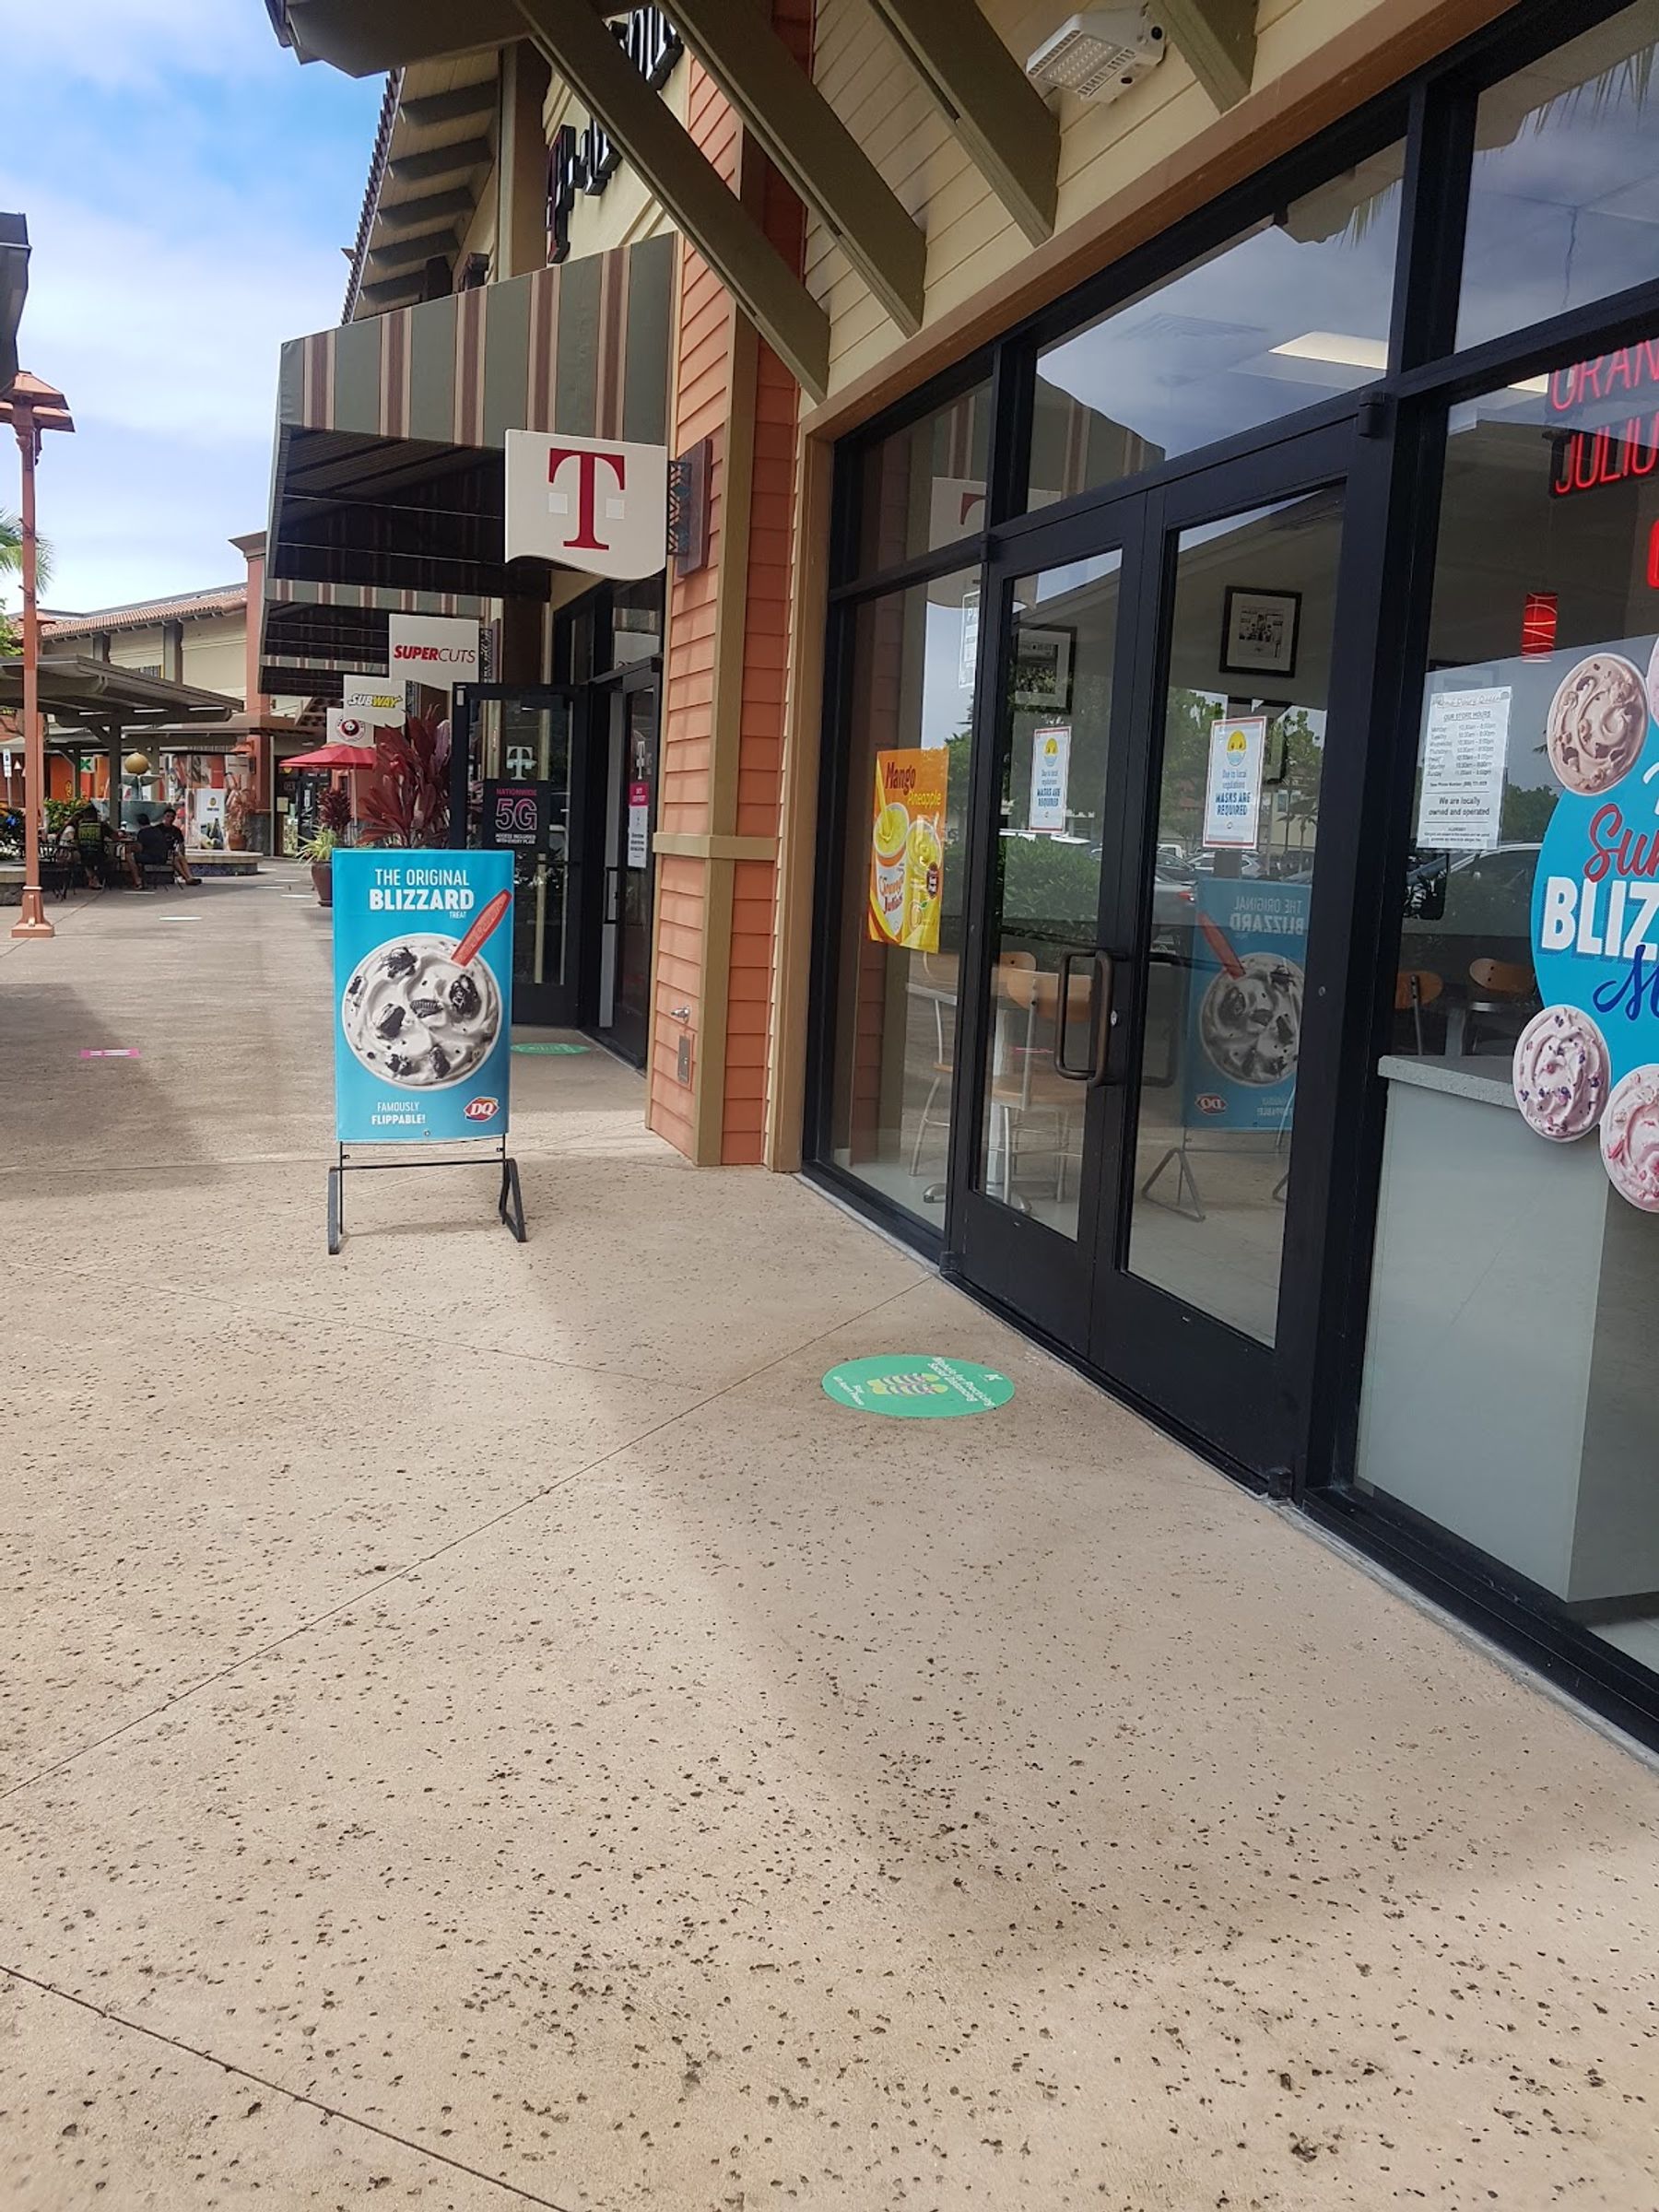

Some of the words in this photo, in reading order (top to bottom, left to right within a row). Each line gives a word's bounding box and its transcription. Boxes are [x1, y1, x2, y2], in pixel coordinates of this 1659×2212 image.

[548, 448, 625, 550] T
[394, 644, 477, 664] SUPERCUTS
[347, 693, 403, 708] SUBWAY
[506, 745, 534, 782] T
[885, 761, 916, 795] Mango
[908, 790, 942, 808] Pineapple
[1216, 793, 1238, 803] MASKS
[1239, 792, 1252, 803] ARE
[495, 798, 537, 830] 5G
[1217, 805, 1248, 816] REQUIRED
[1583, 802, 1659, 884] Su
[374, 868, 402, 886] THE
[406, 868, 470, 886] ORIGINAL
[369, 888, 475, 911] BLIZZARD
[449, 911, 467, 919] TREAT
[377, 1101, 420, 1112] FAMOUSLY
[465, 1102, 494, 1116] DQ
[371, 1113, 427, 1124] FLIPPABLE!
